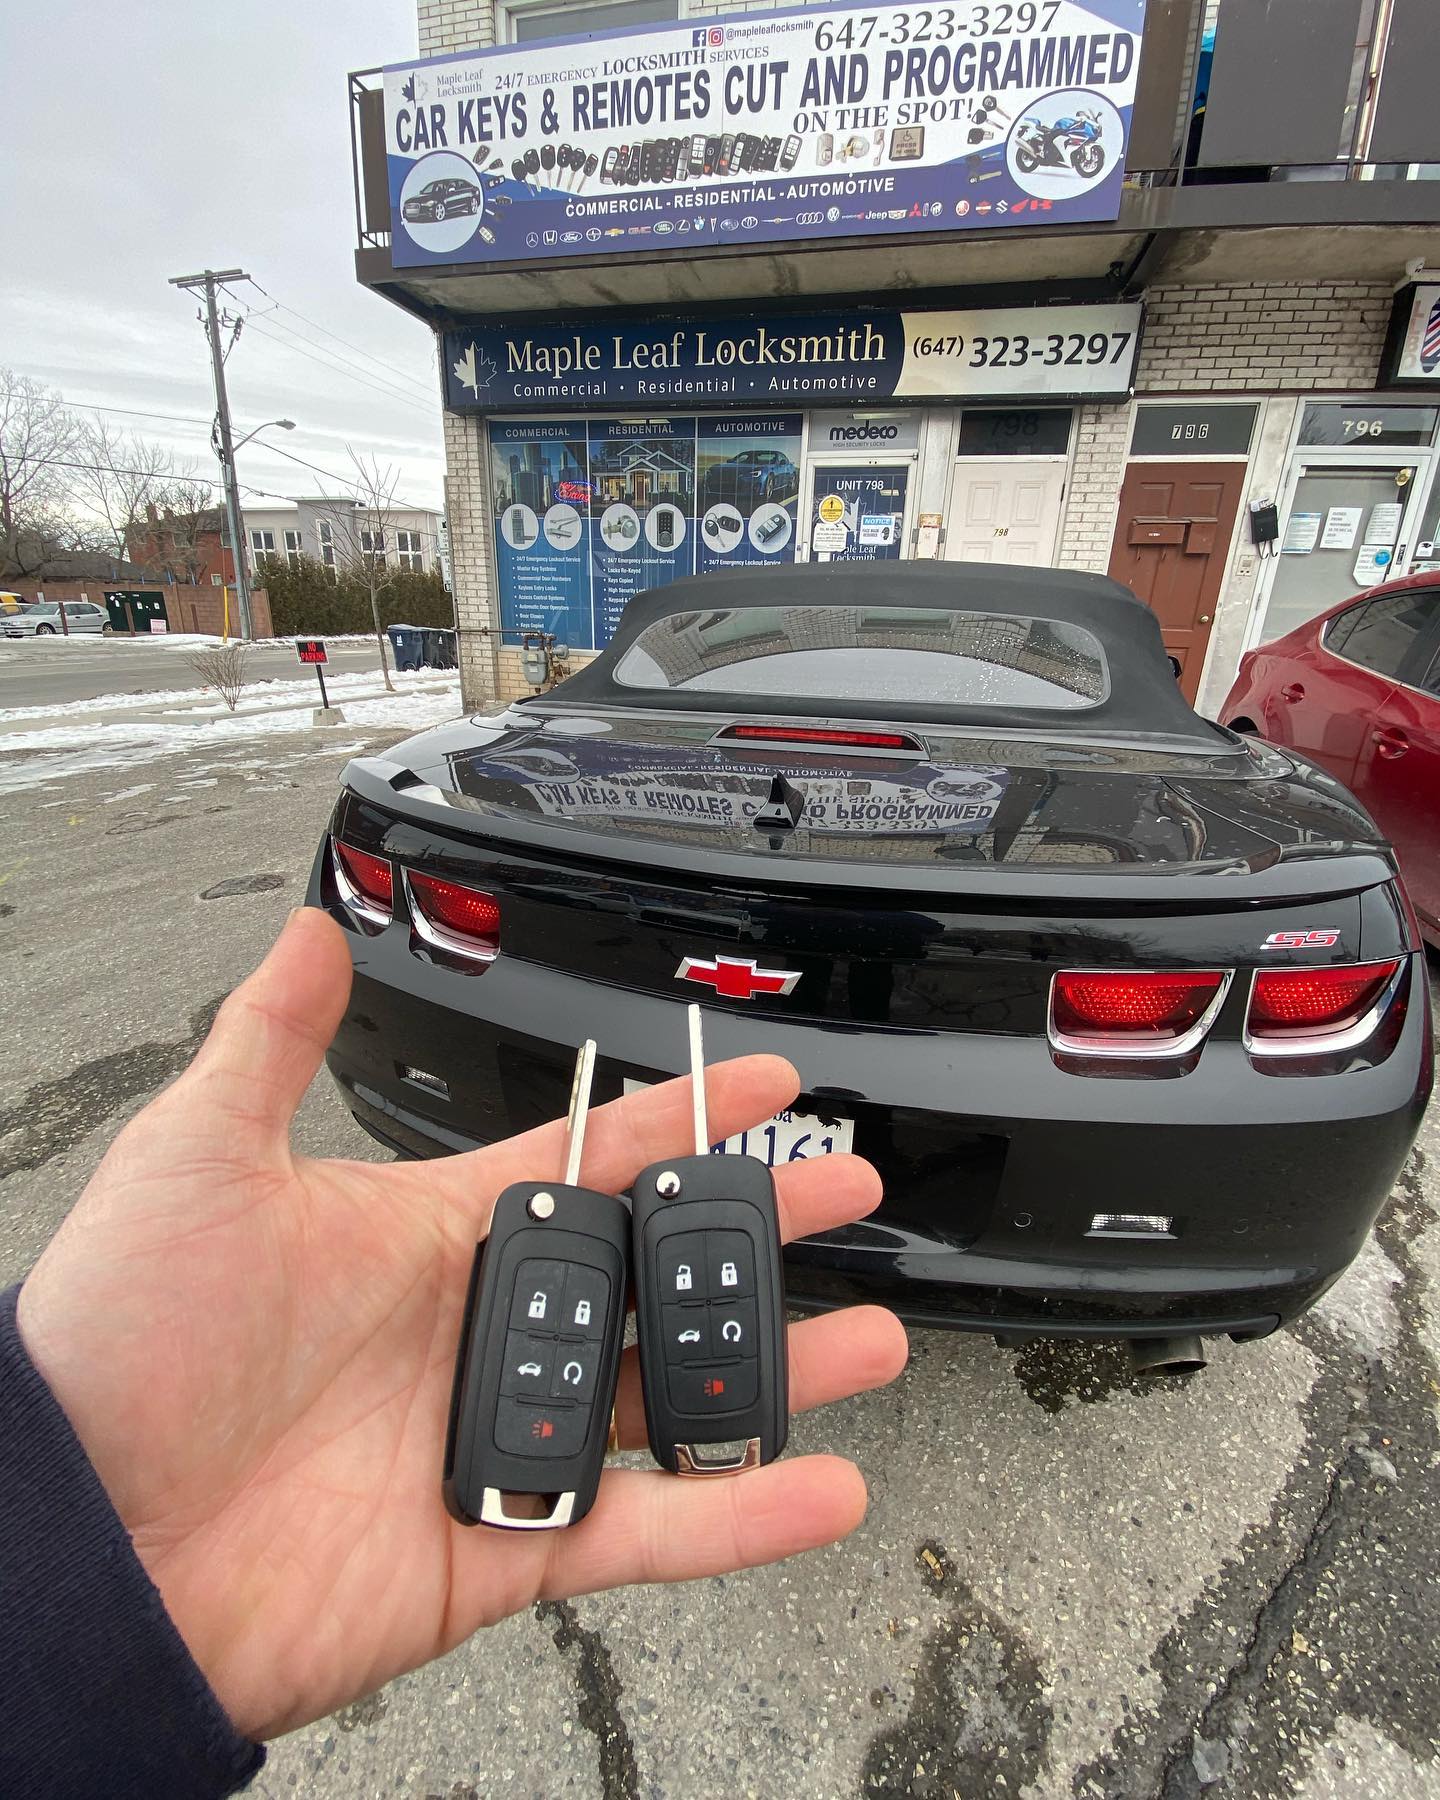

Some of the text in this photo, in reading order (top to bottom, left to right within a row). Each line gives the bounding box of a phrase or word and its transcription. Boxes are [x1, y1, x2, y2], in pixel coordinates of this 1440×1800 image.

[726, 19, 814, 40] @mapleleaflocksmith
[815, 1, 1062, 52] 647-323-3297
[437, 68, 484, 88] Maple Leaf
[495, 46, 769, 90] 24/7 EMERGENCY LOCKSMITH SERVICES
[396, 32, 1134, 153] CAR KEYS & REMOTES CUT AND PROGRAMMED
[437, 82, 482, 97] Locksmith
[793, 97, 973, 134] ON THE SPOT!
[566, 177, 895, 217] COMMERCIAL RESIDENTIAL AUTOMOTIVE
[865, 210, 888, 220] Jeep
[505, 323, 886, 380] Maple Leaf Locksmith
[912, 332, 1132, 368] (647) 323-3297
[513, 374, 877, 398] Commercial Residential Automotive
[505, 427, 570, 438] COMMERCIAL
[608, 424, 675, 435] RESIDENTIAL
[715, 421, 785, 433] AUTOMOTIVE
[829, 419, 898, 440] medeco
[992, 413, 1038, 436] 798
[1171, 424, 1209, 439] 796
[1342, 420, 1383, 436] 796
[836, 480, 884, 490] UNIT 798
[993, 528, 1009, 538] 798
[844, 545, 877, 555] ple Leaf
[300, 651, 326, 661] PARKING
[307, 641, 317, 651] NO
[1260, 929, 1340, 950] SS
